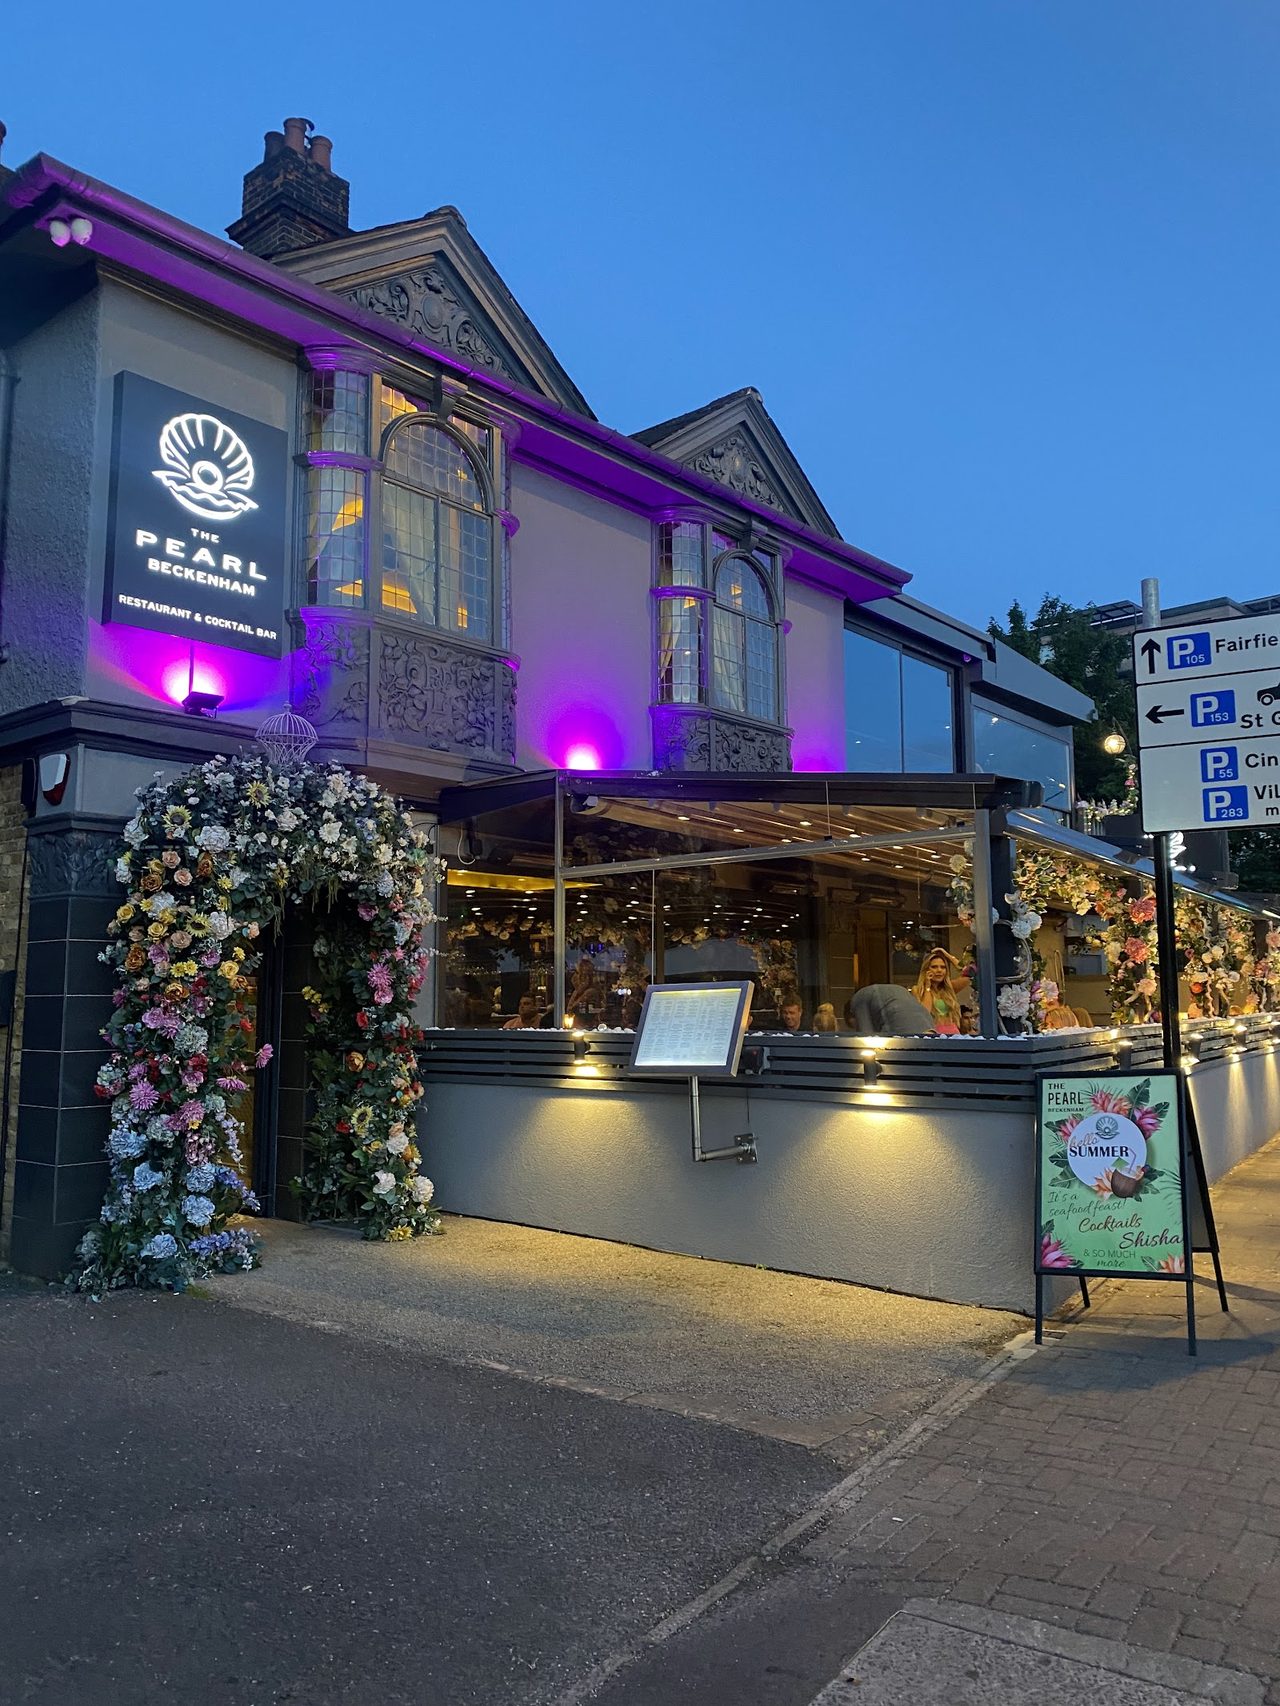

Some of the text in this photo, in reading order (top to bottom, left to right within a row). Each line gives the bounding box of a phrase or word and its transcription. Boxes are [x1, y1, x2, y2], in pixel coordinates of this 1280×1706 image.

[190, 527, 220, 544] THE
[135, 528, 267, 581] PEARL
[147, 557, 256, 597] BECKENHAM
[118, 594, 277, 640] RESTAURANT & COCKTAIL BAR
[1186, 655, 1205, 664] 105
[1210, 712, 1229, 722] 153
[1240, 713, 1264, 729] St
[1219, 768, 1233, 779] 55
[1245, 753, 1279, 768] Cin
[1221, 808, 1243, 818] 283
[1048, 1091, 1084, 1105] PEARL
[1070, 1132, 1099, 1147] hello
[1069, 1145, 1129, 1158] SUMMER
[1049, 1198, 1127, 1219] seafood feast!
[1079, 1213, 1142, 1233] Cocktails
[1119, 1228, 1181, 1249] Shisha
[1083, 1248, 1135, 1259] & SO MUCH
[1096, 1259, 1125, 1267] more
